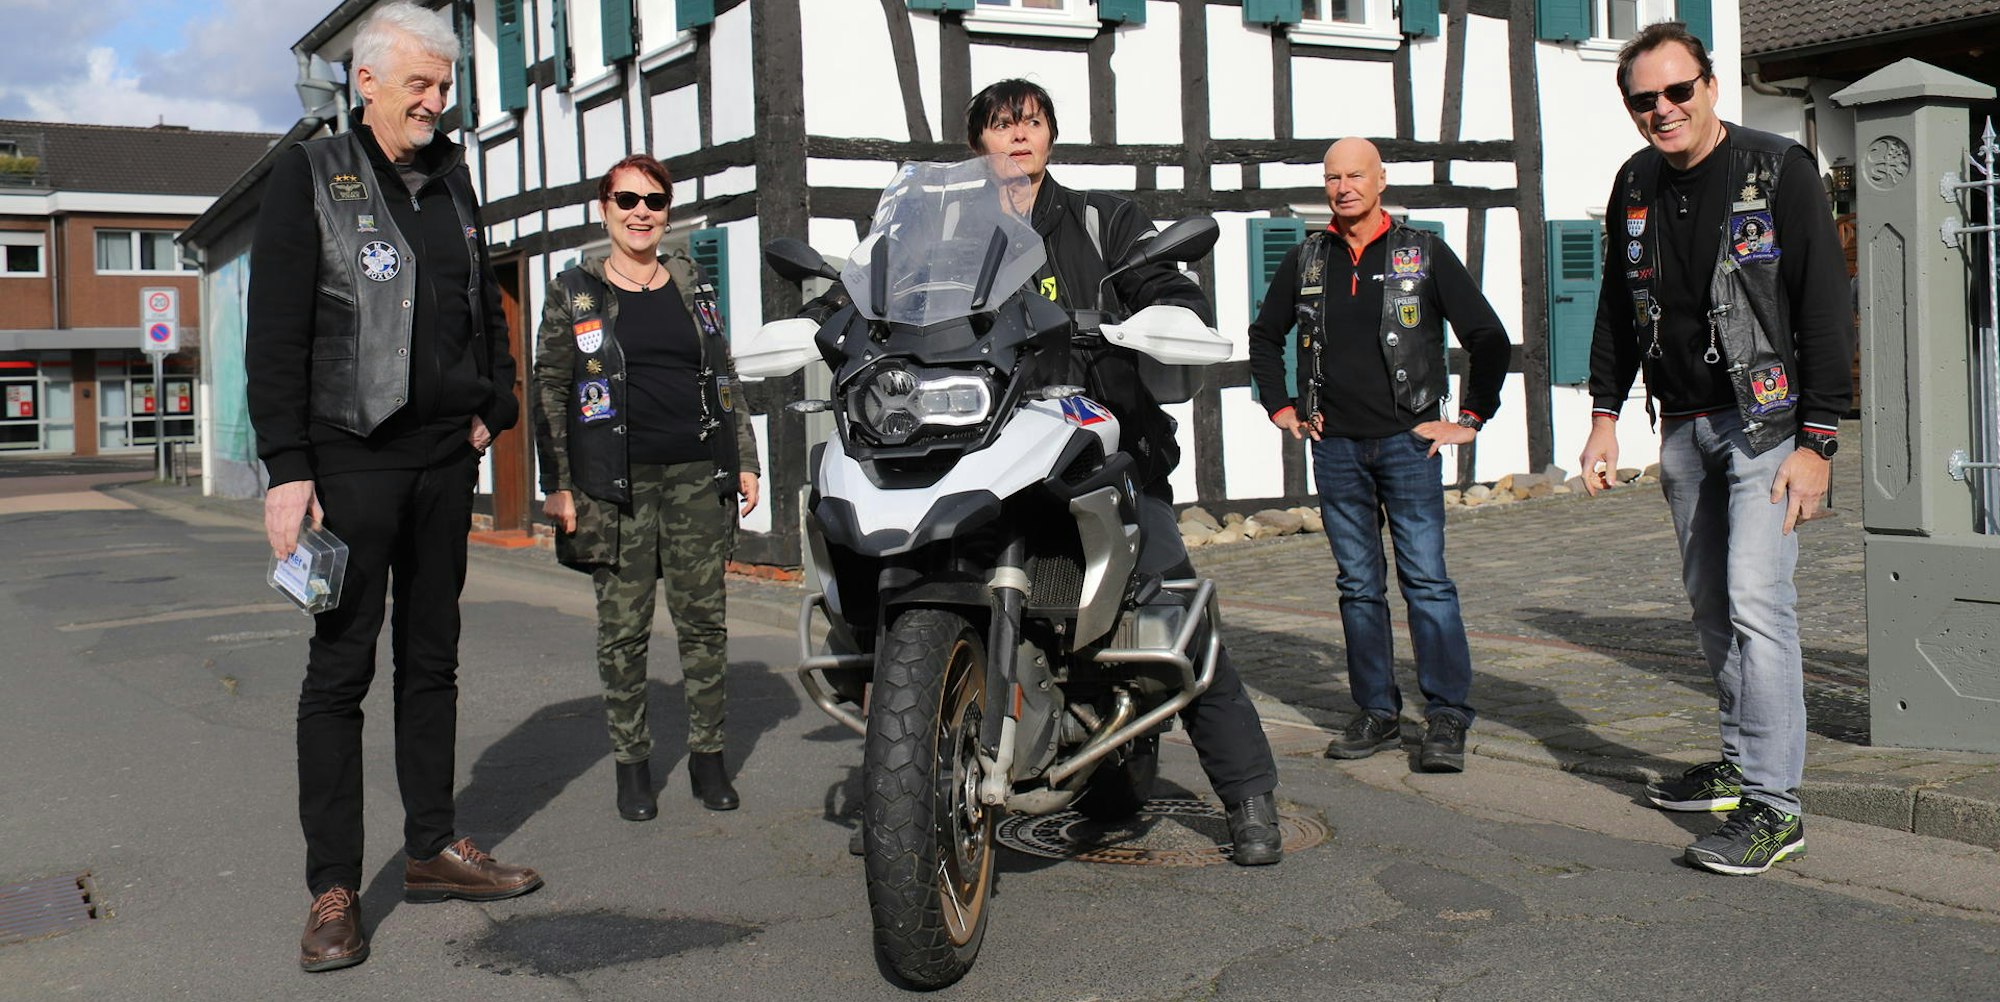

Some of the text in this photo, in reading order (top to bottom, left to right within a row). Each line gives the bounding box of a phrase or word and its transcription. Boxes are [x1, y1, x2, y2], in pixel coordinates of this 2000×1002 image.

[362, 243, 396, 255] BMW
[365, 268, 396, 280] BOXER
[154, 297, 166, 308] 20
